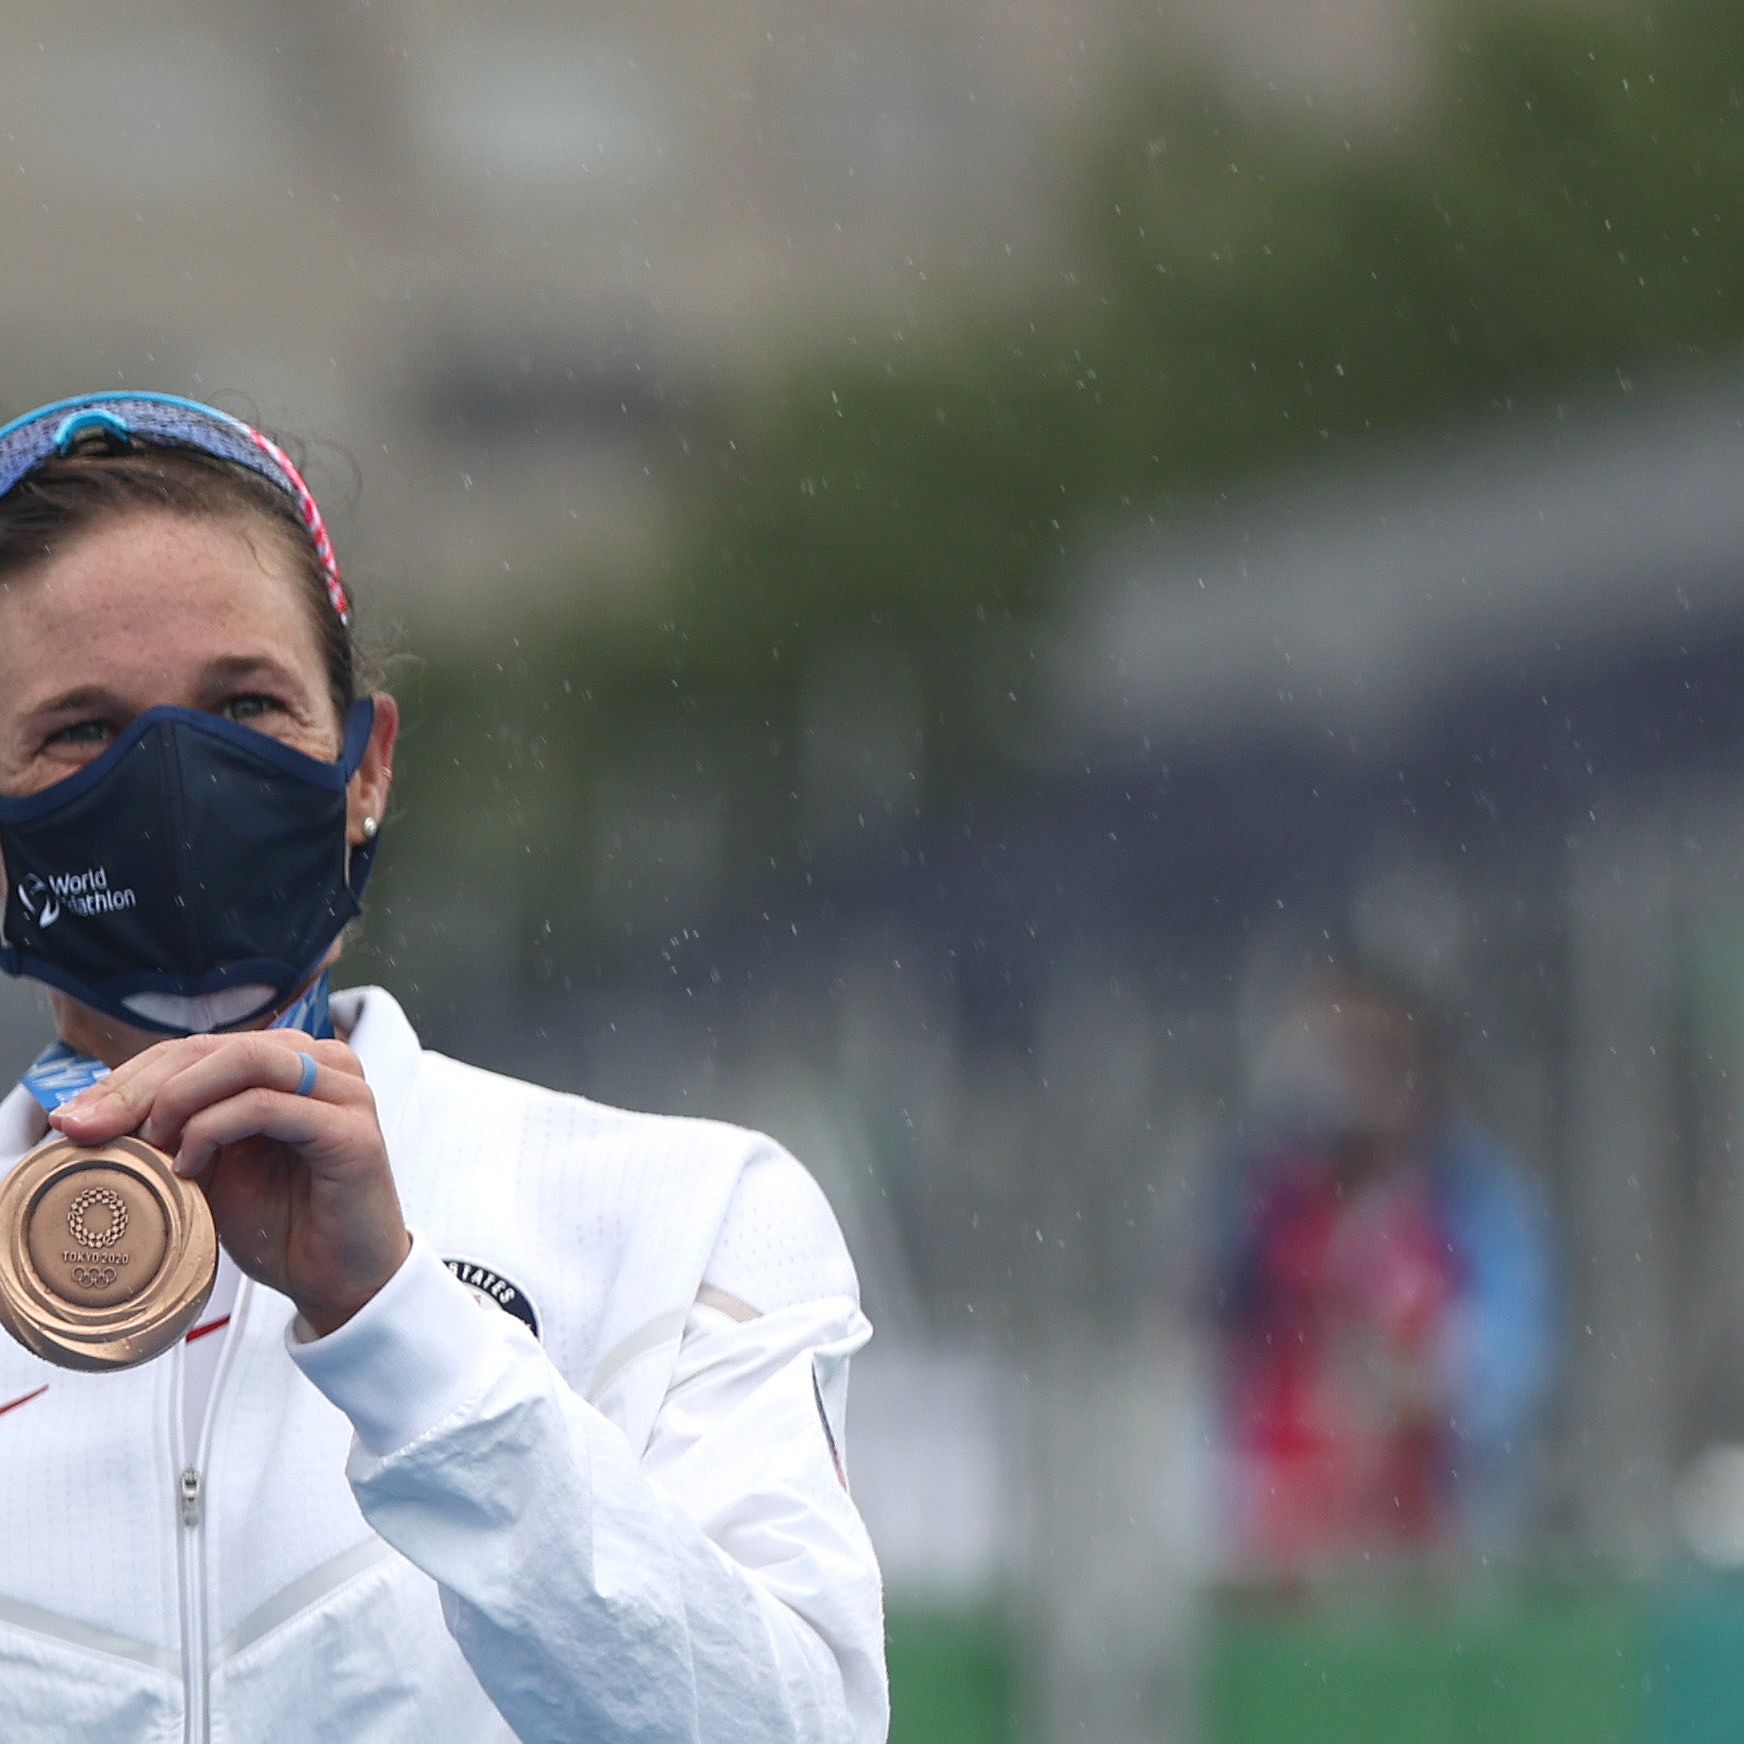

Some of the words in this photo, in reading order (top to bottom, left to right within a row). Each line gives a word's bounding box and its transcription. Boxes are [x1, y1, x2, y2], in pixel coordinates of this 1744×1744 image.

[48, 867, 107, 895] World
[62, 887, 136, 917] iathlon
[63, 1250, 99, 1262] TOKYO
[101, 1252, 129, 1265] 2020
